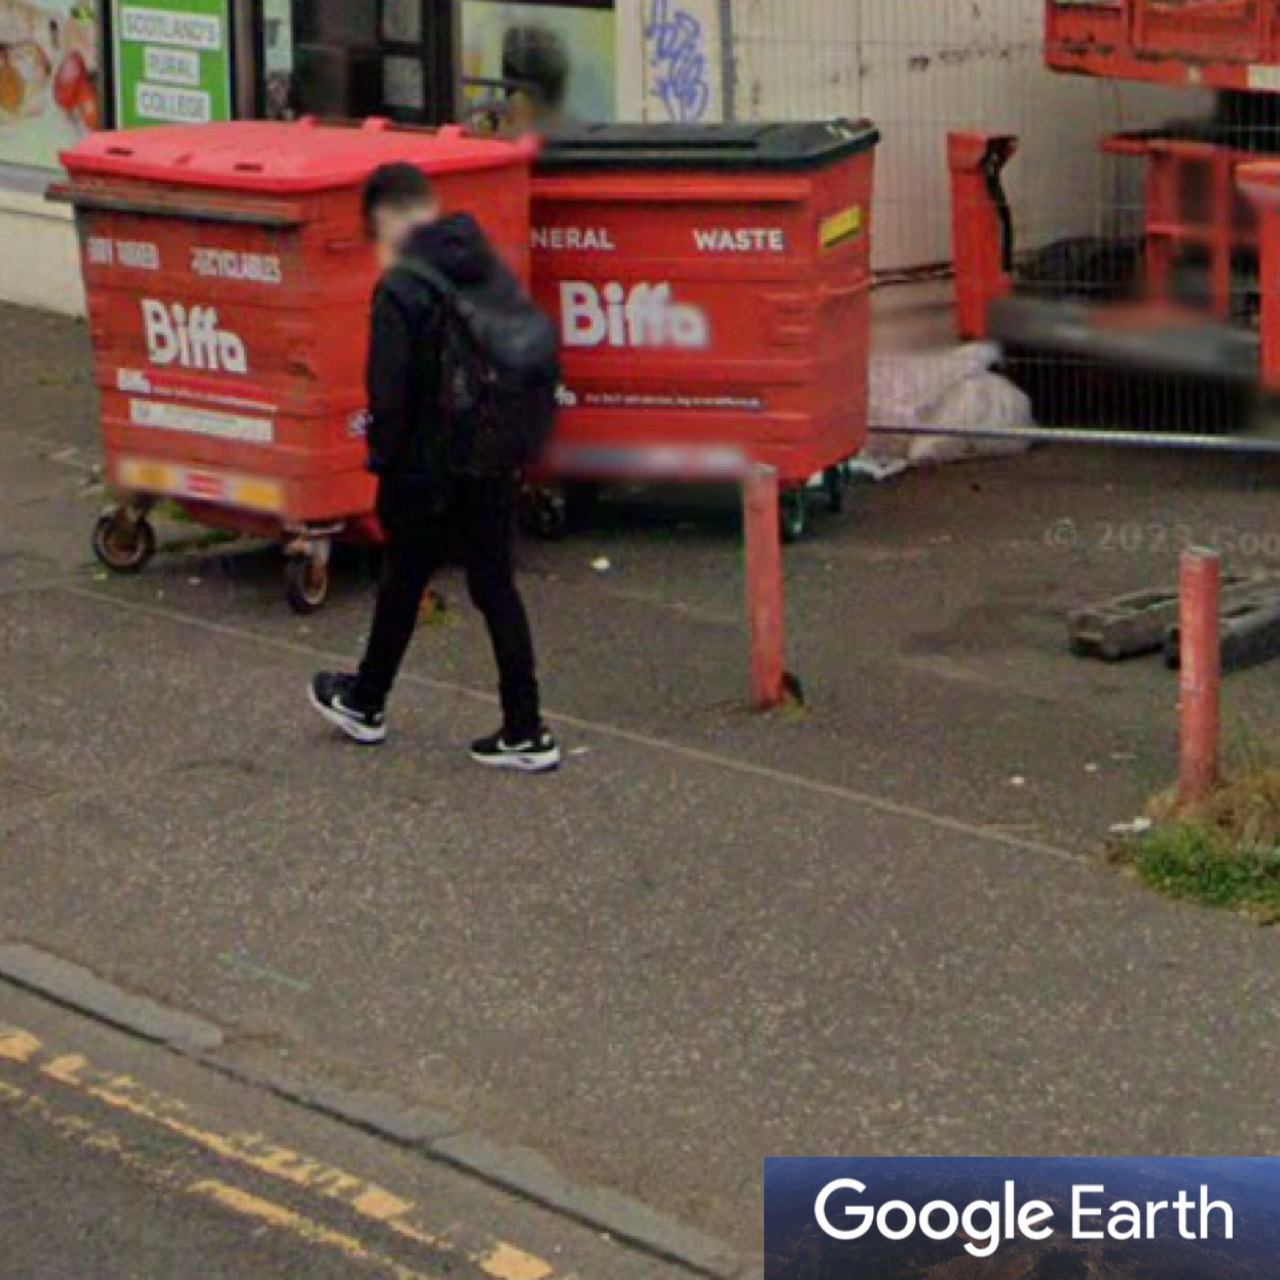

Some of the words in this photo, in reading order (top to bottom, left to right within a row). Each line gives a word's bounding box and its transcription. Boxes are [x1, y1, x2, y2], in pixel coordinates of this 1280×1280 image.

[531, 228, 615, 251] NERAL
[693, 228, 784, 251] WASTE
[141, 299, 248, 373] Biffa
[558, 280, 709, 347] Biffa
